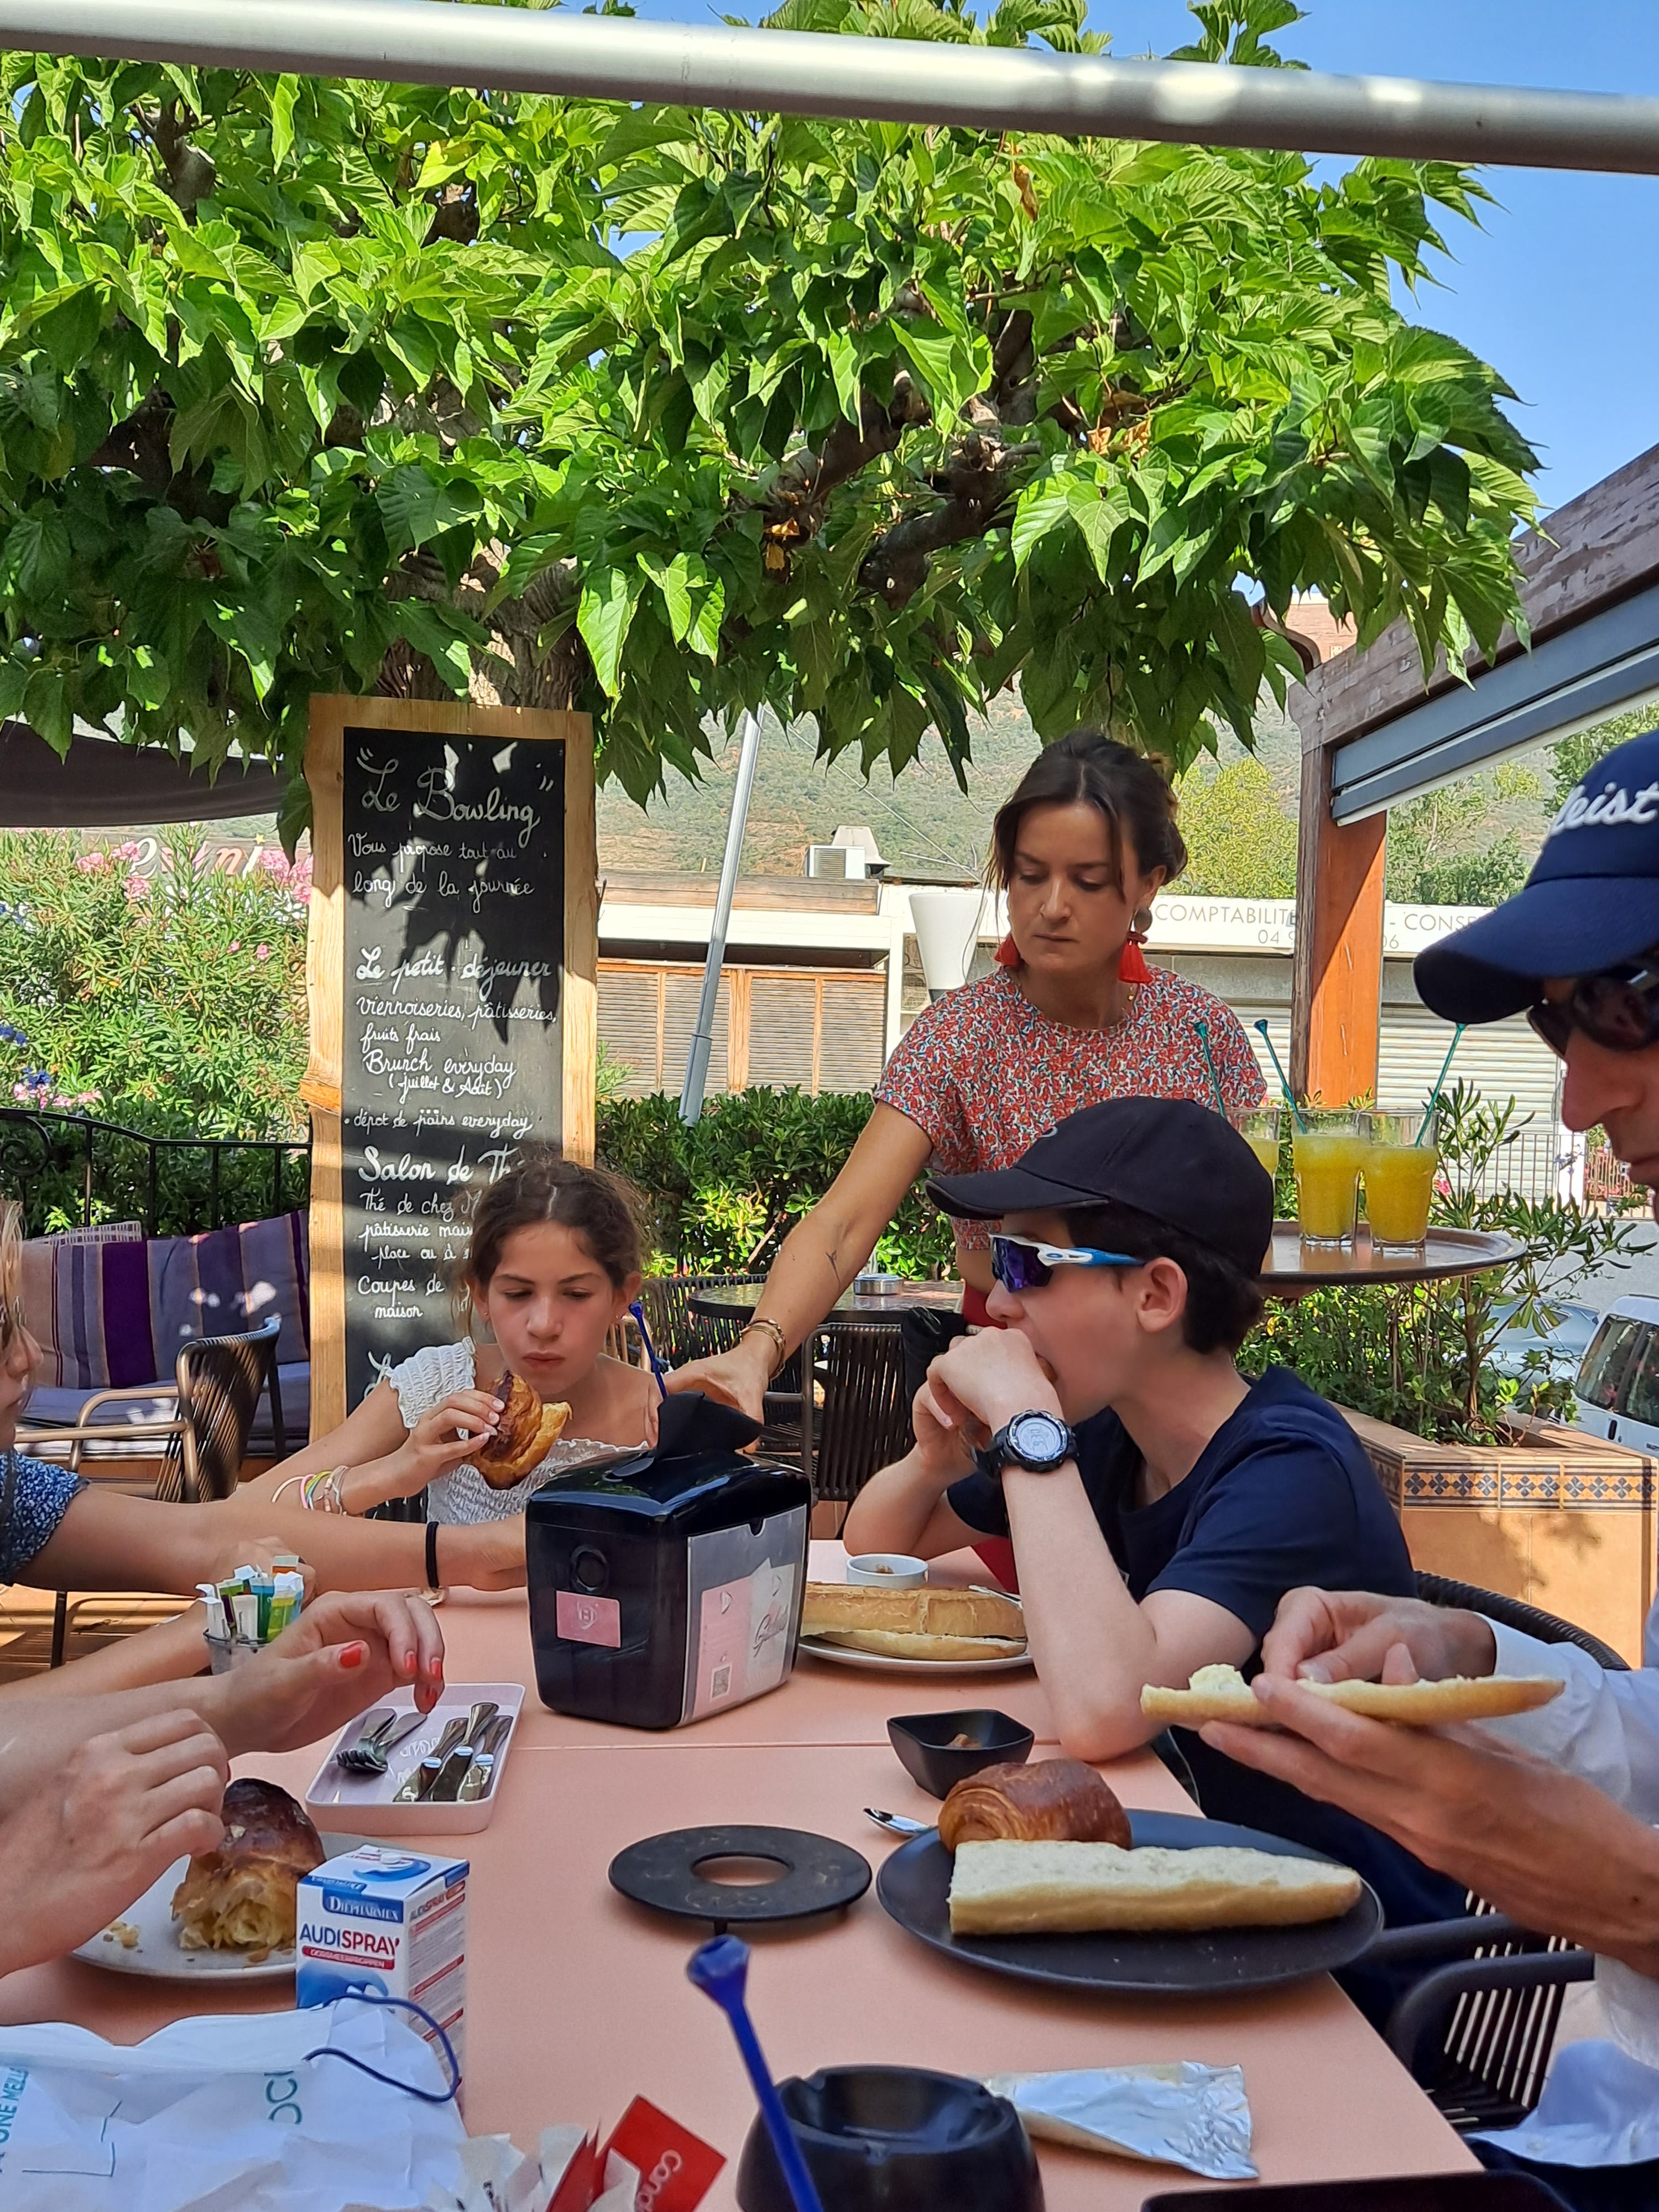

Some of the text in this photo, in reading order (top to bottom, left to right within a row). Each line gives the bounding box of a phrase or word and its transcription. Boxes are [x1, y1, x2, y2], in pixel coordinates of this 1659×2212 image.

[348, 832, 517, 873] Vous propose tout au
[352, 870, 535, 913] long de la journée
[1258, 930, 1280, 945] 04
[356, 946, 553, 1002] Le petit déjeuner
[359, 1022, 442, 1055] fruits frais
[363, 1047, 518, 1089] Brunch everyday
[442, 1077, 456, 1094] &
[392, 1109, 408, 1129] de
[413, 1109, 455, 1137] pains
[461, 1110, 533, 1140] everyday
[358, 1145, 436, 1183] Salon
[446, 1144, 474, 1186] de
[359, 1186, 387, 1212] Thé
[397, 1192, 415, 1216] de
[421, 1192, 454, 1222] chez
[358, 1220, 431, 1253] pâtisserie
[371, 1244, 411, 1271] place
[420, 1248, 437, 1260] ou
[443, 1243, 457, 1261] à
[358, 1275, 416, 1307] Coupes
[425, 1272, 446, 1297] de
[375, 1301, 424, 1319] maison
[299, 1923, 400, 1956] AUDISPRAY
